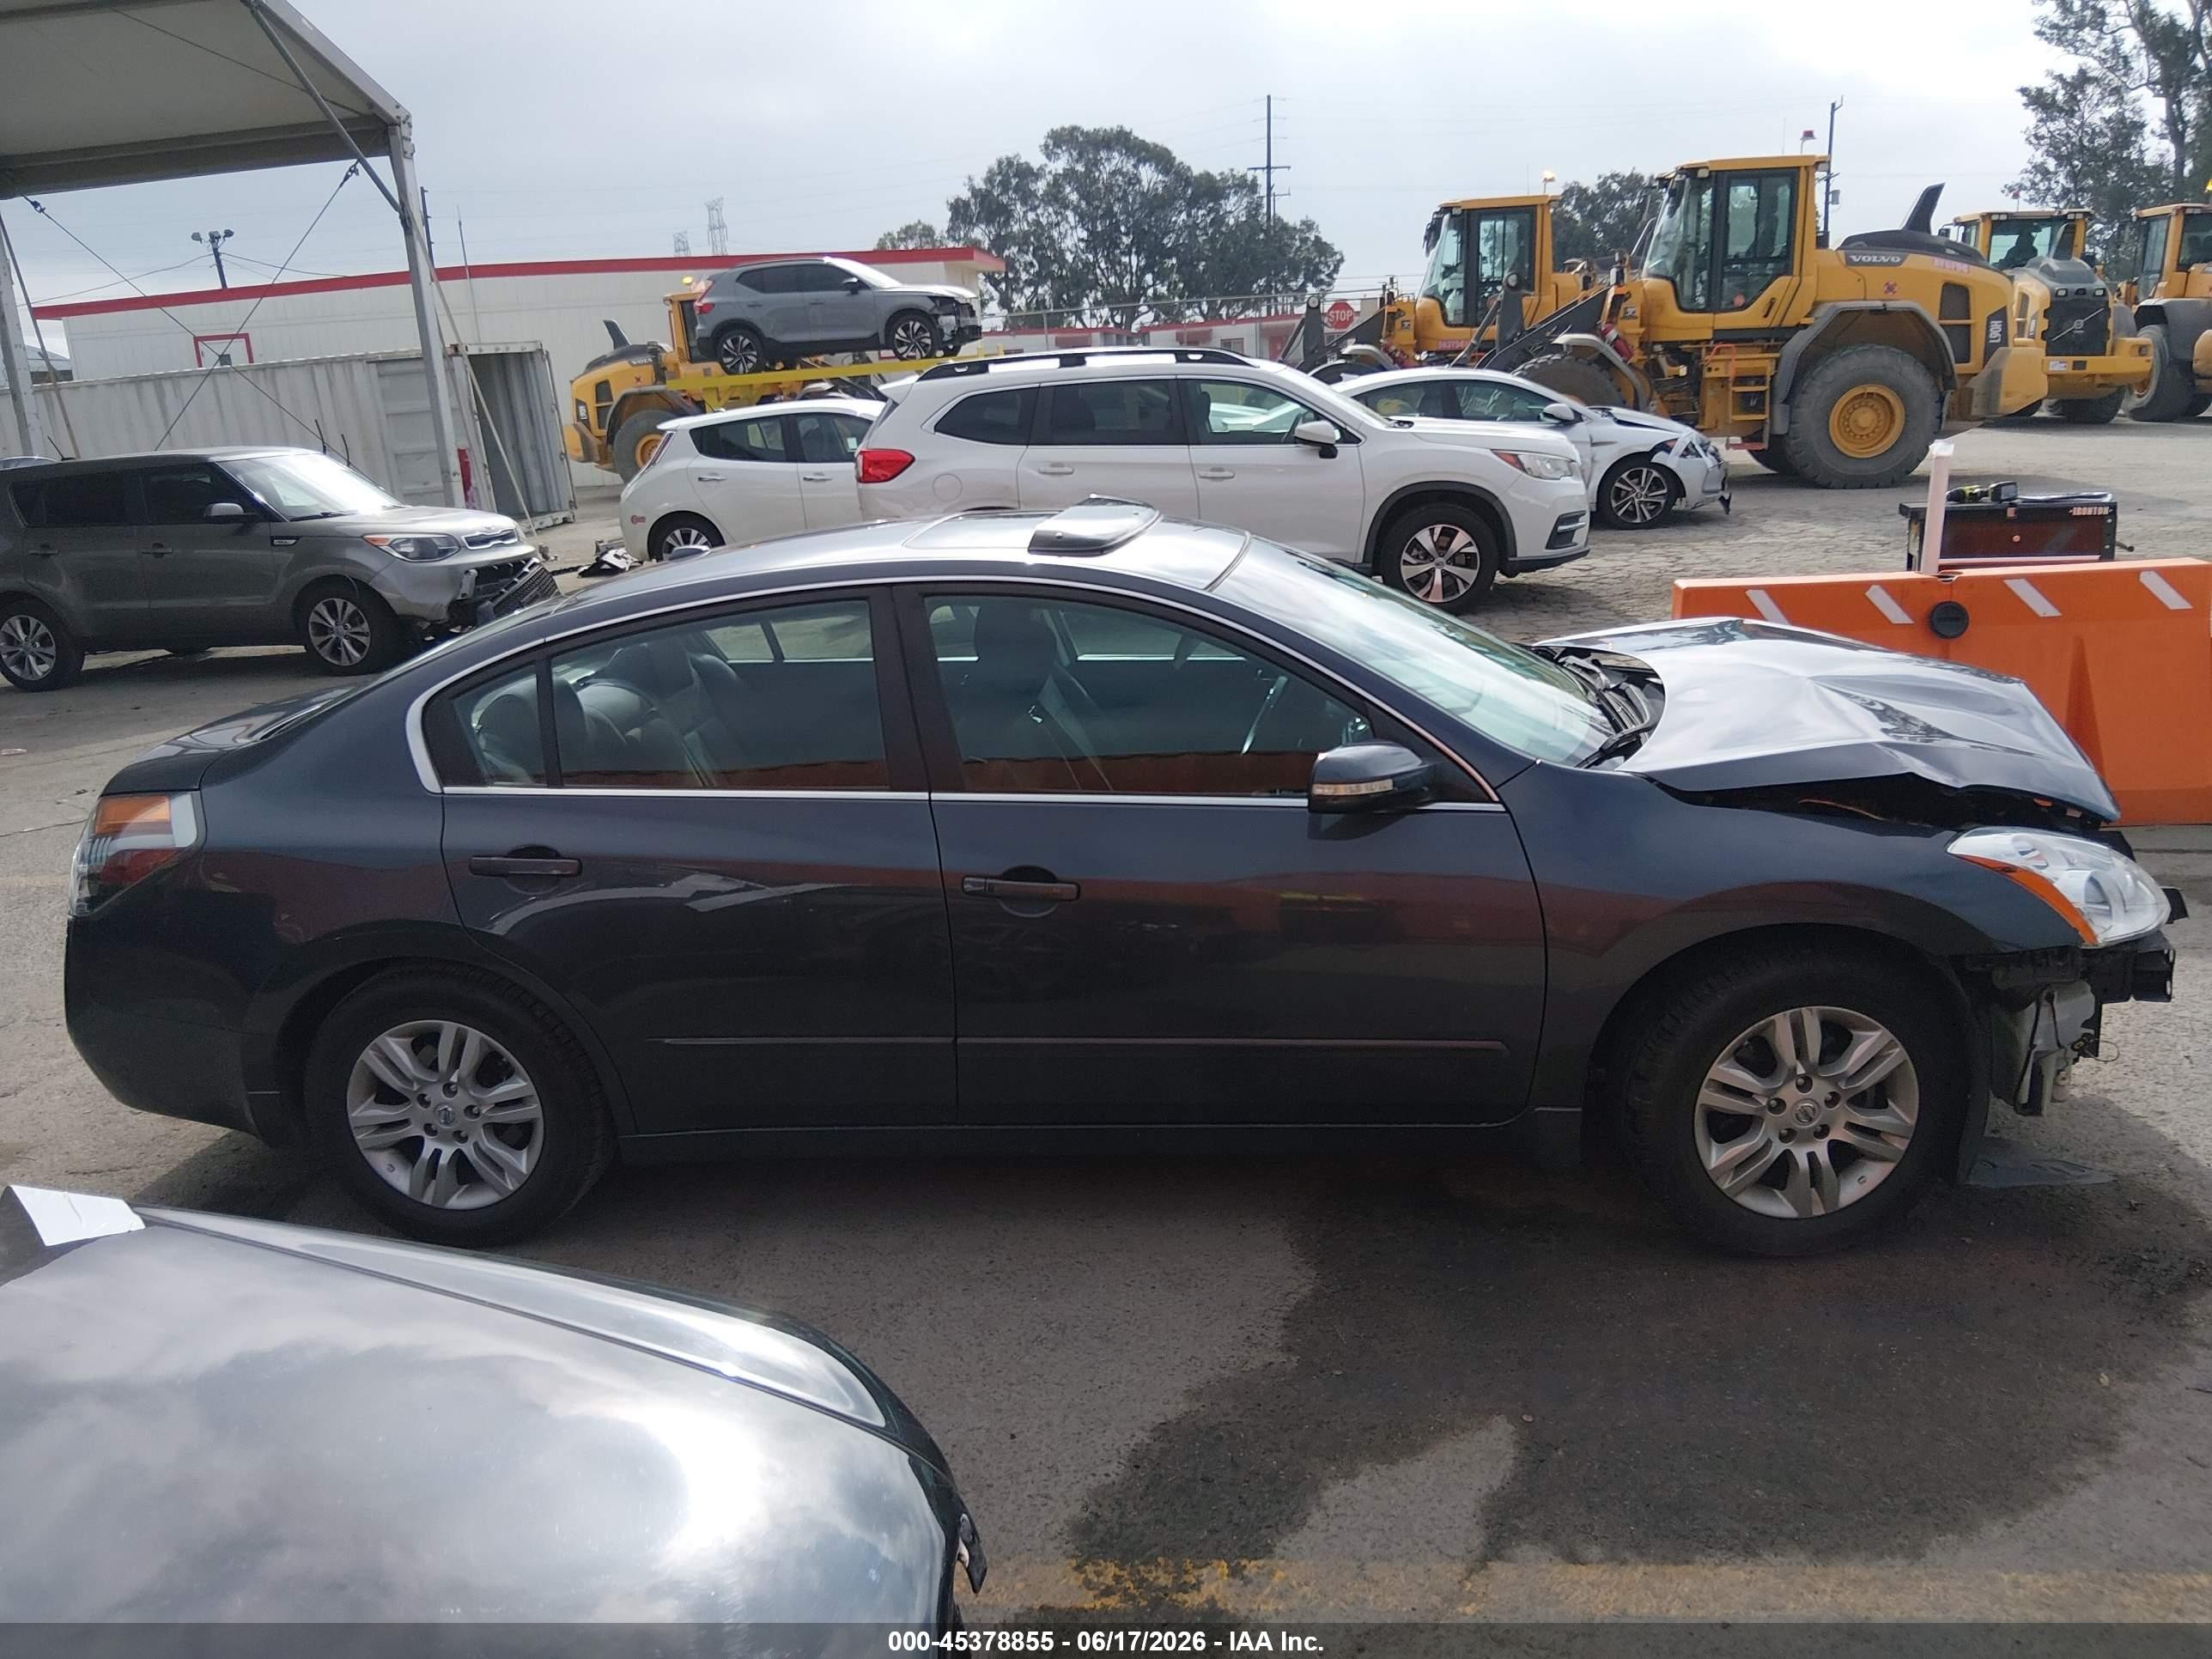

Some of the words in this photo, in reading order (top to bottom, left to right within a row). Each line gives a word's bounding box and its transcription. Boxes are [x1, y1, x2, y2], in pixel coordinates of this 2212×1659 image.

[1849, 253, 1902, 264] VOLVO
[1328, 310, 1353, 322] STOP
[1988, 320, 2003, 343] L90H
[2071, 507, 2110, 516] IRONTON
